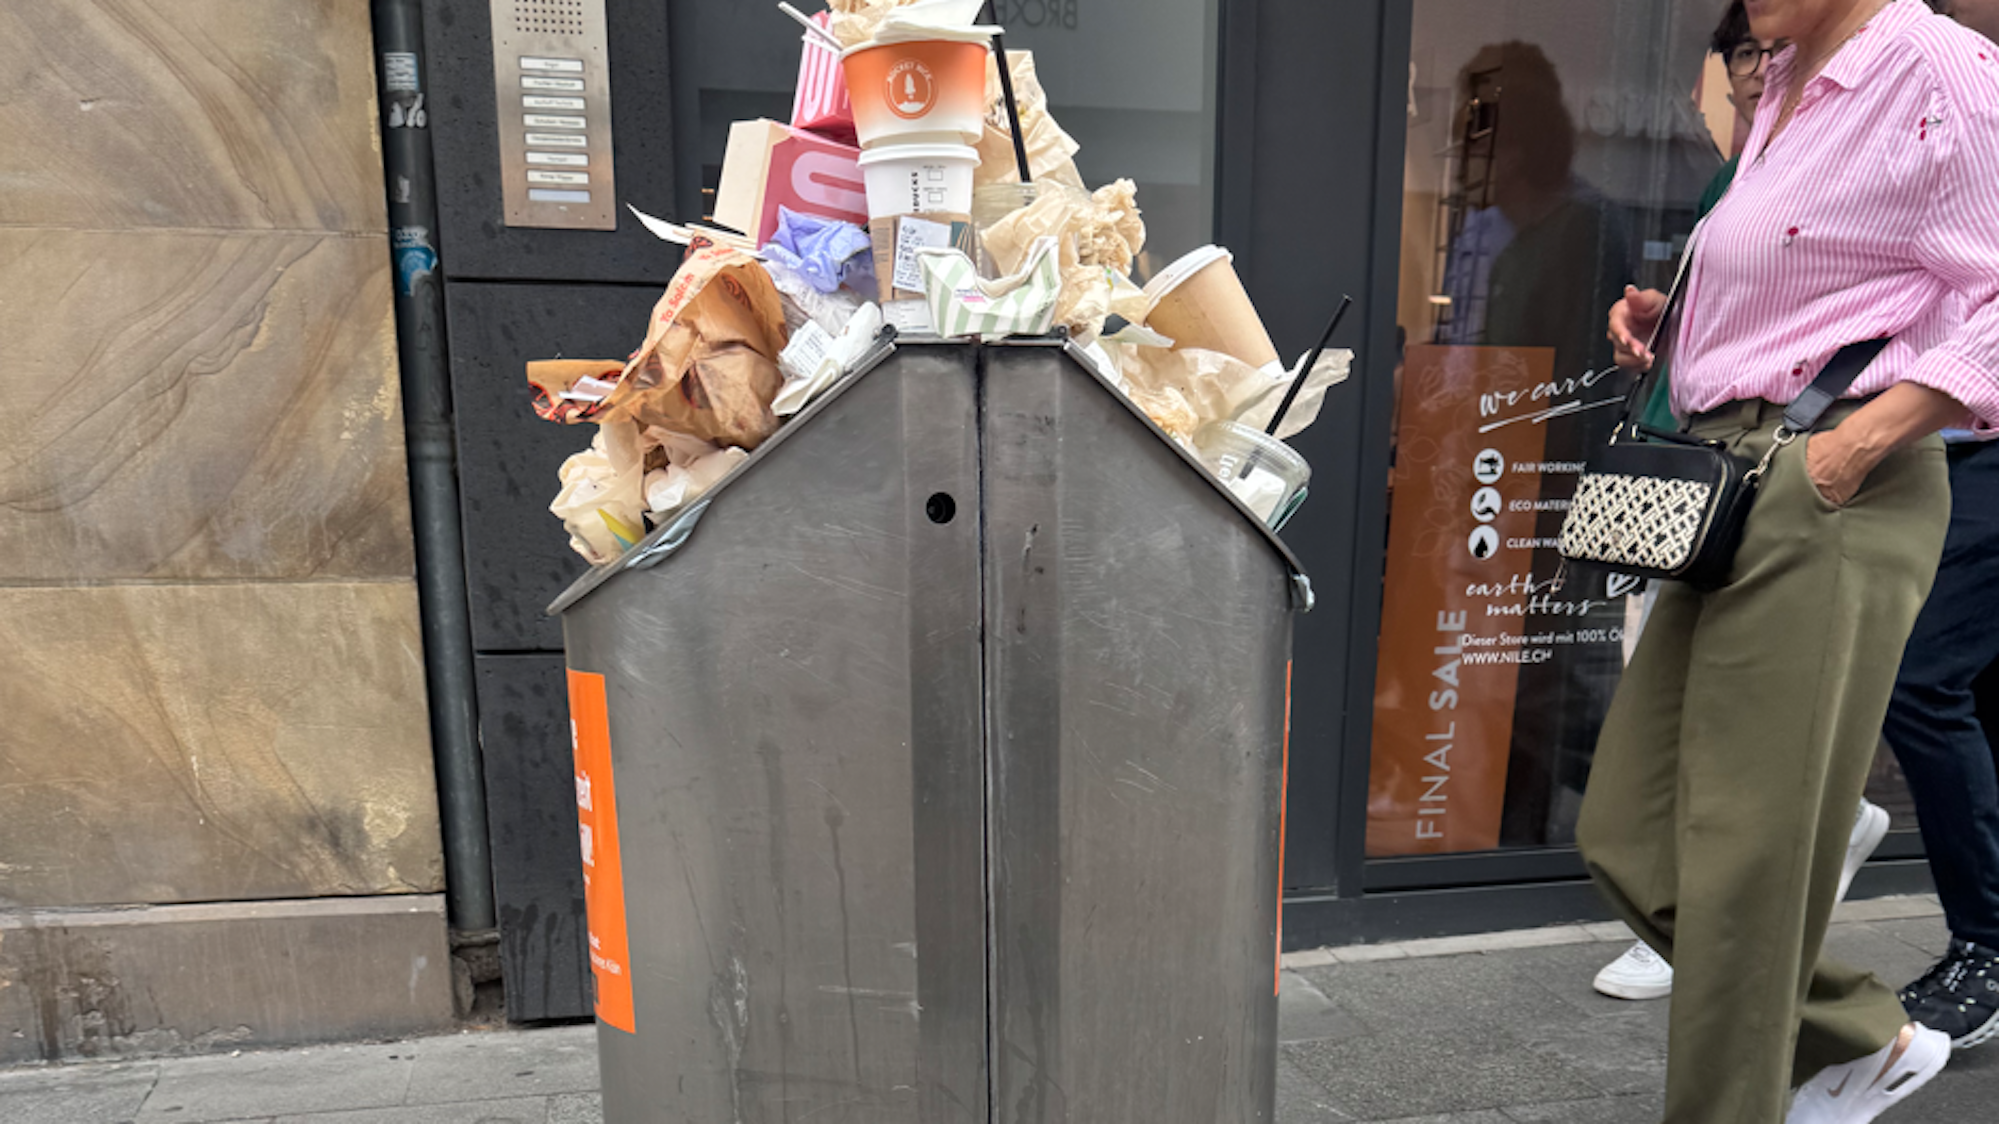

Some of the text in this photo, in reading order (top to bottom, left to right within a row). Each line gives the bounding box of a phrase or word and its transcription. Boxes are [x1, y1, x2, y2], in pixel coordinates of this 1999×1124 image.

[1479, 365, 1620, 417] we care
[1511, 461, 1536, 473] FAIR
[1508, 500, 1532, 512] ECO
[1506, 537, 1541, 549] CLEAN
[1466, 572, 1556, 597] earth
[1486, 592, 1607, 616] matters
[1461, 633, 1498, 647] Dieser
[1500, 631, 1528, 646] Store
[1530, 631, 1553, 644] wird
[1555, 630, 1575, 644] mit
[1576, 629, 1607, 643] 100%
[1415, 609, 1468, 839] FINAL SALE
